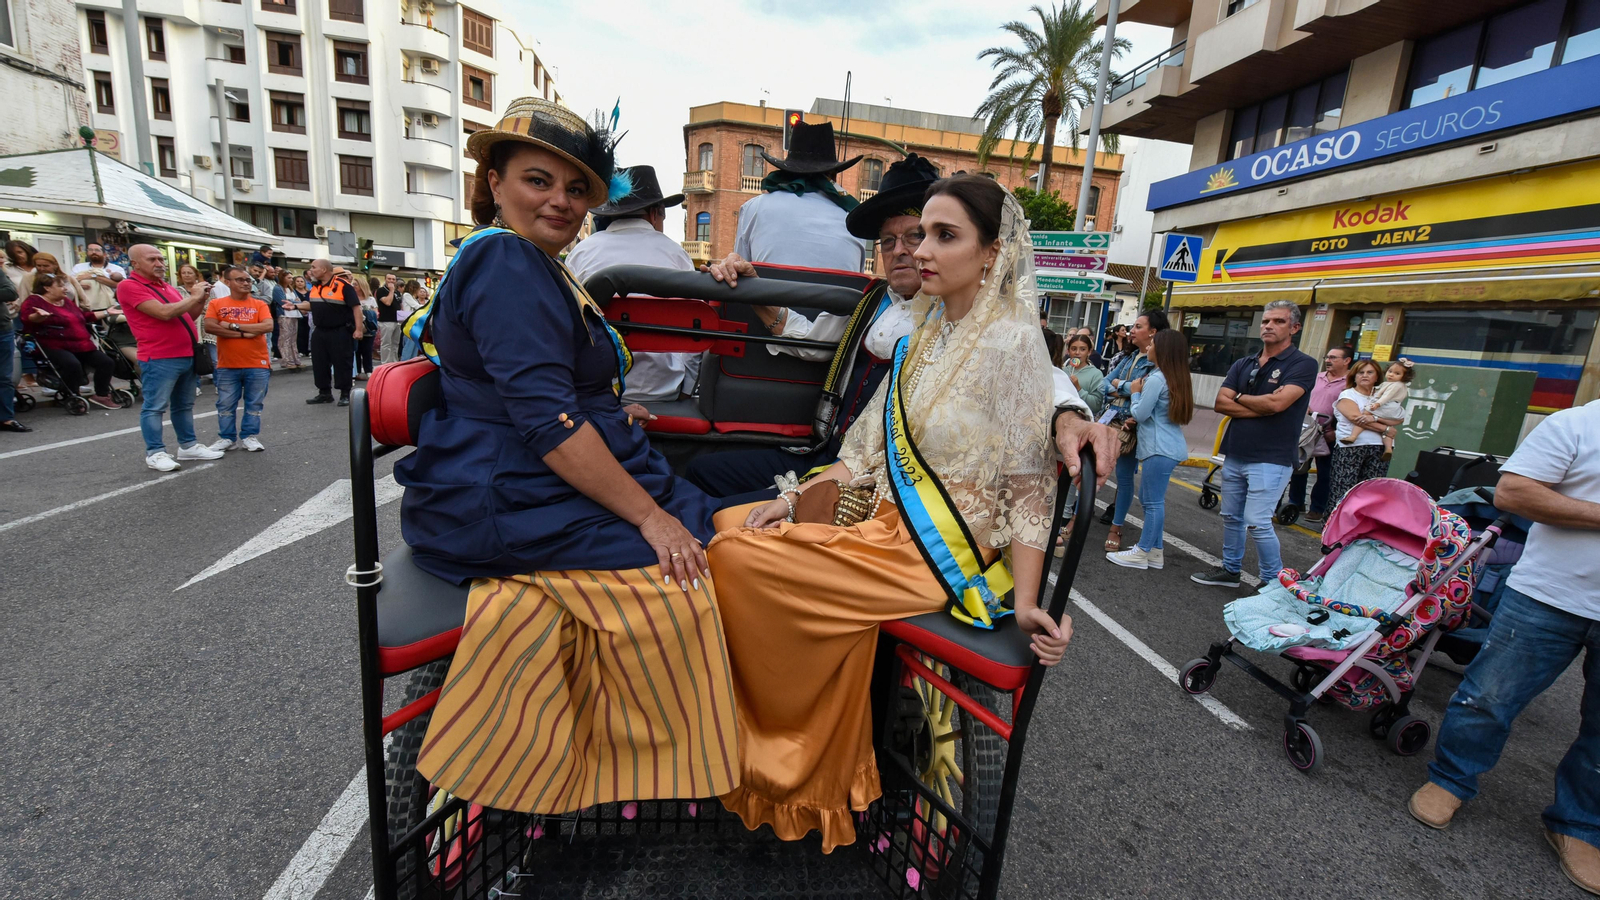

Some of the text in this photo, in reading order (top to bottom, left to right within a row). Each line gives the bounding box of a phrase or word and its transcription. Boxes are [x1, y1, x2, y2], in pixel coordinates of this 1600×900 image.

[1250, 100, 1503, 180] OCASO SEGUROS
[1332, 200, 1412, 229] Kodak
[1311, 236, 1348, 252] FOTO
[893, 447, 923, 487] 2023
